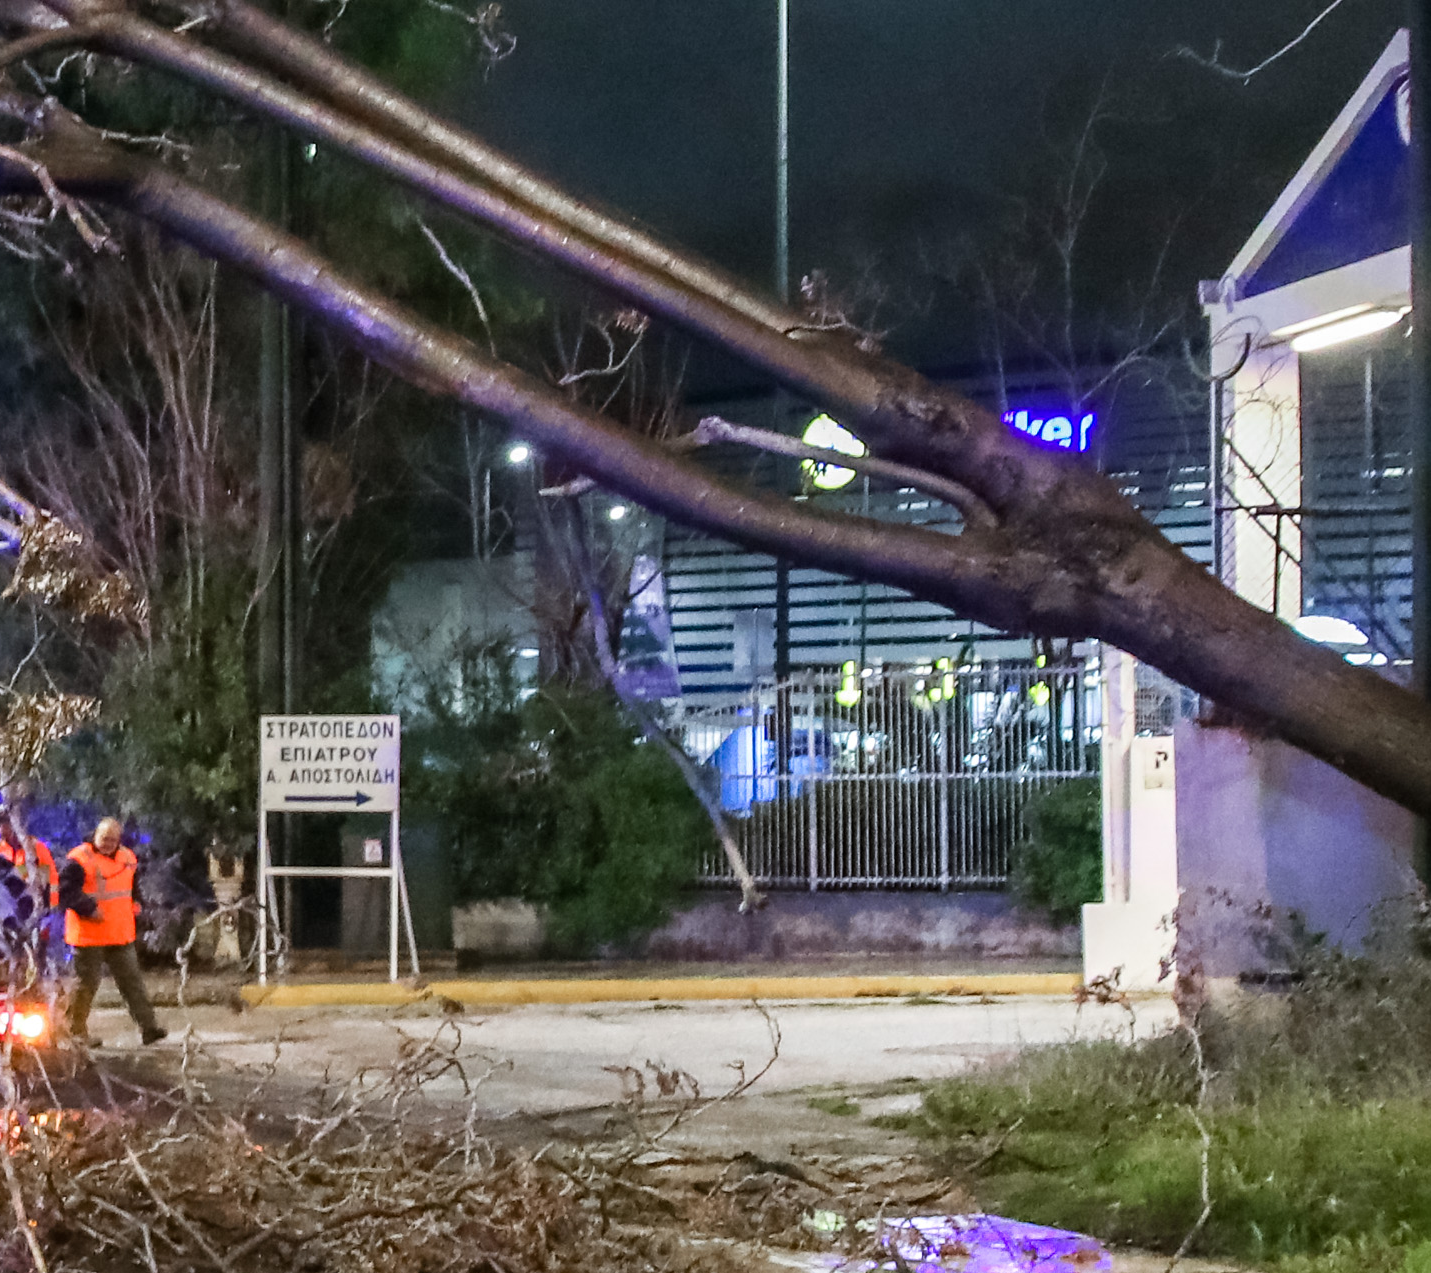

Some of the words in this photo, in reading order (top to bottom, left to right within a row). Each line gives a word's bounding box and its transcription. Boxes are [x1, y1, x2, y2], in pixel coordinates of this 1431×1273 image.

[266, 721, 394, 738] ΣΤΡΑΤΟΠΕΔΟΝ
[280, 747, 378, 762] ΕΠΙΑΤΡΟΥ
[289, 769, 395, 784] ΑΠΟΣΤΟΛΙΔΗ
